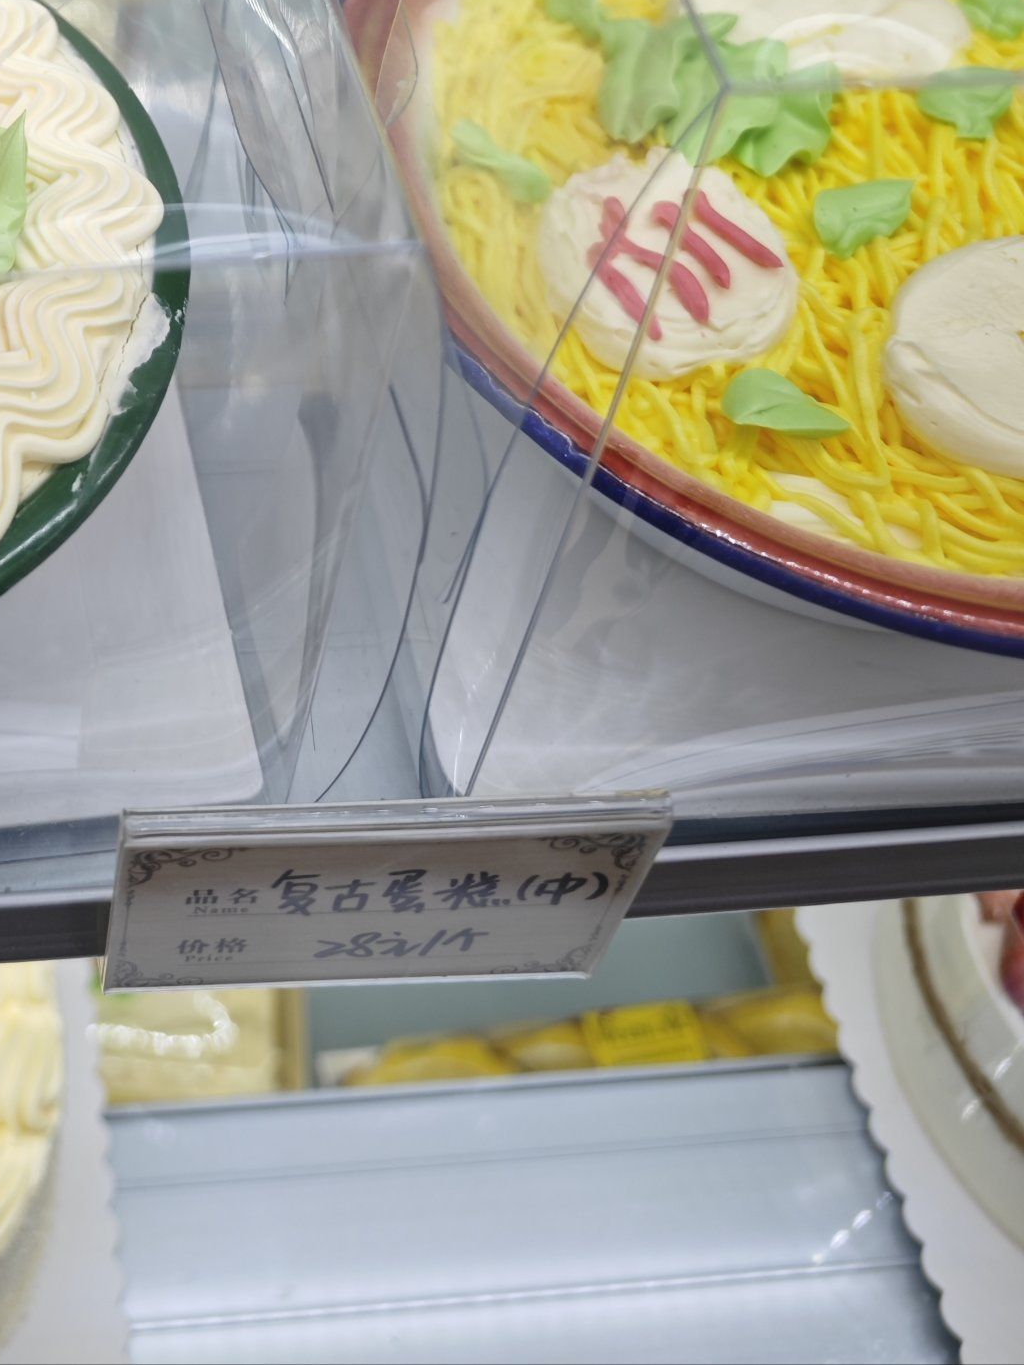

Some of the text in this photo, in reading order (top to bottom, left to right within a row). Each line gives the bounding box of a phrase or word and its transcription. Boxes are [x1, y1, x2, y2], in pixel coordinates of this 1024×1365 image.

[184, 887, 260, 905] 品名
[192, 905, 250, 915] Name
[177, 937, 249, 955] 价格
[184, 953, 234, 963] Price
